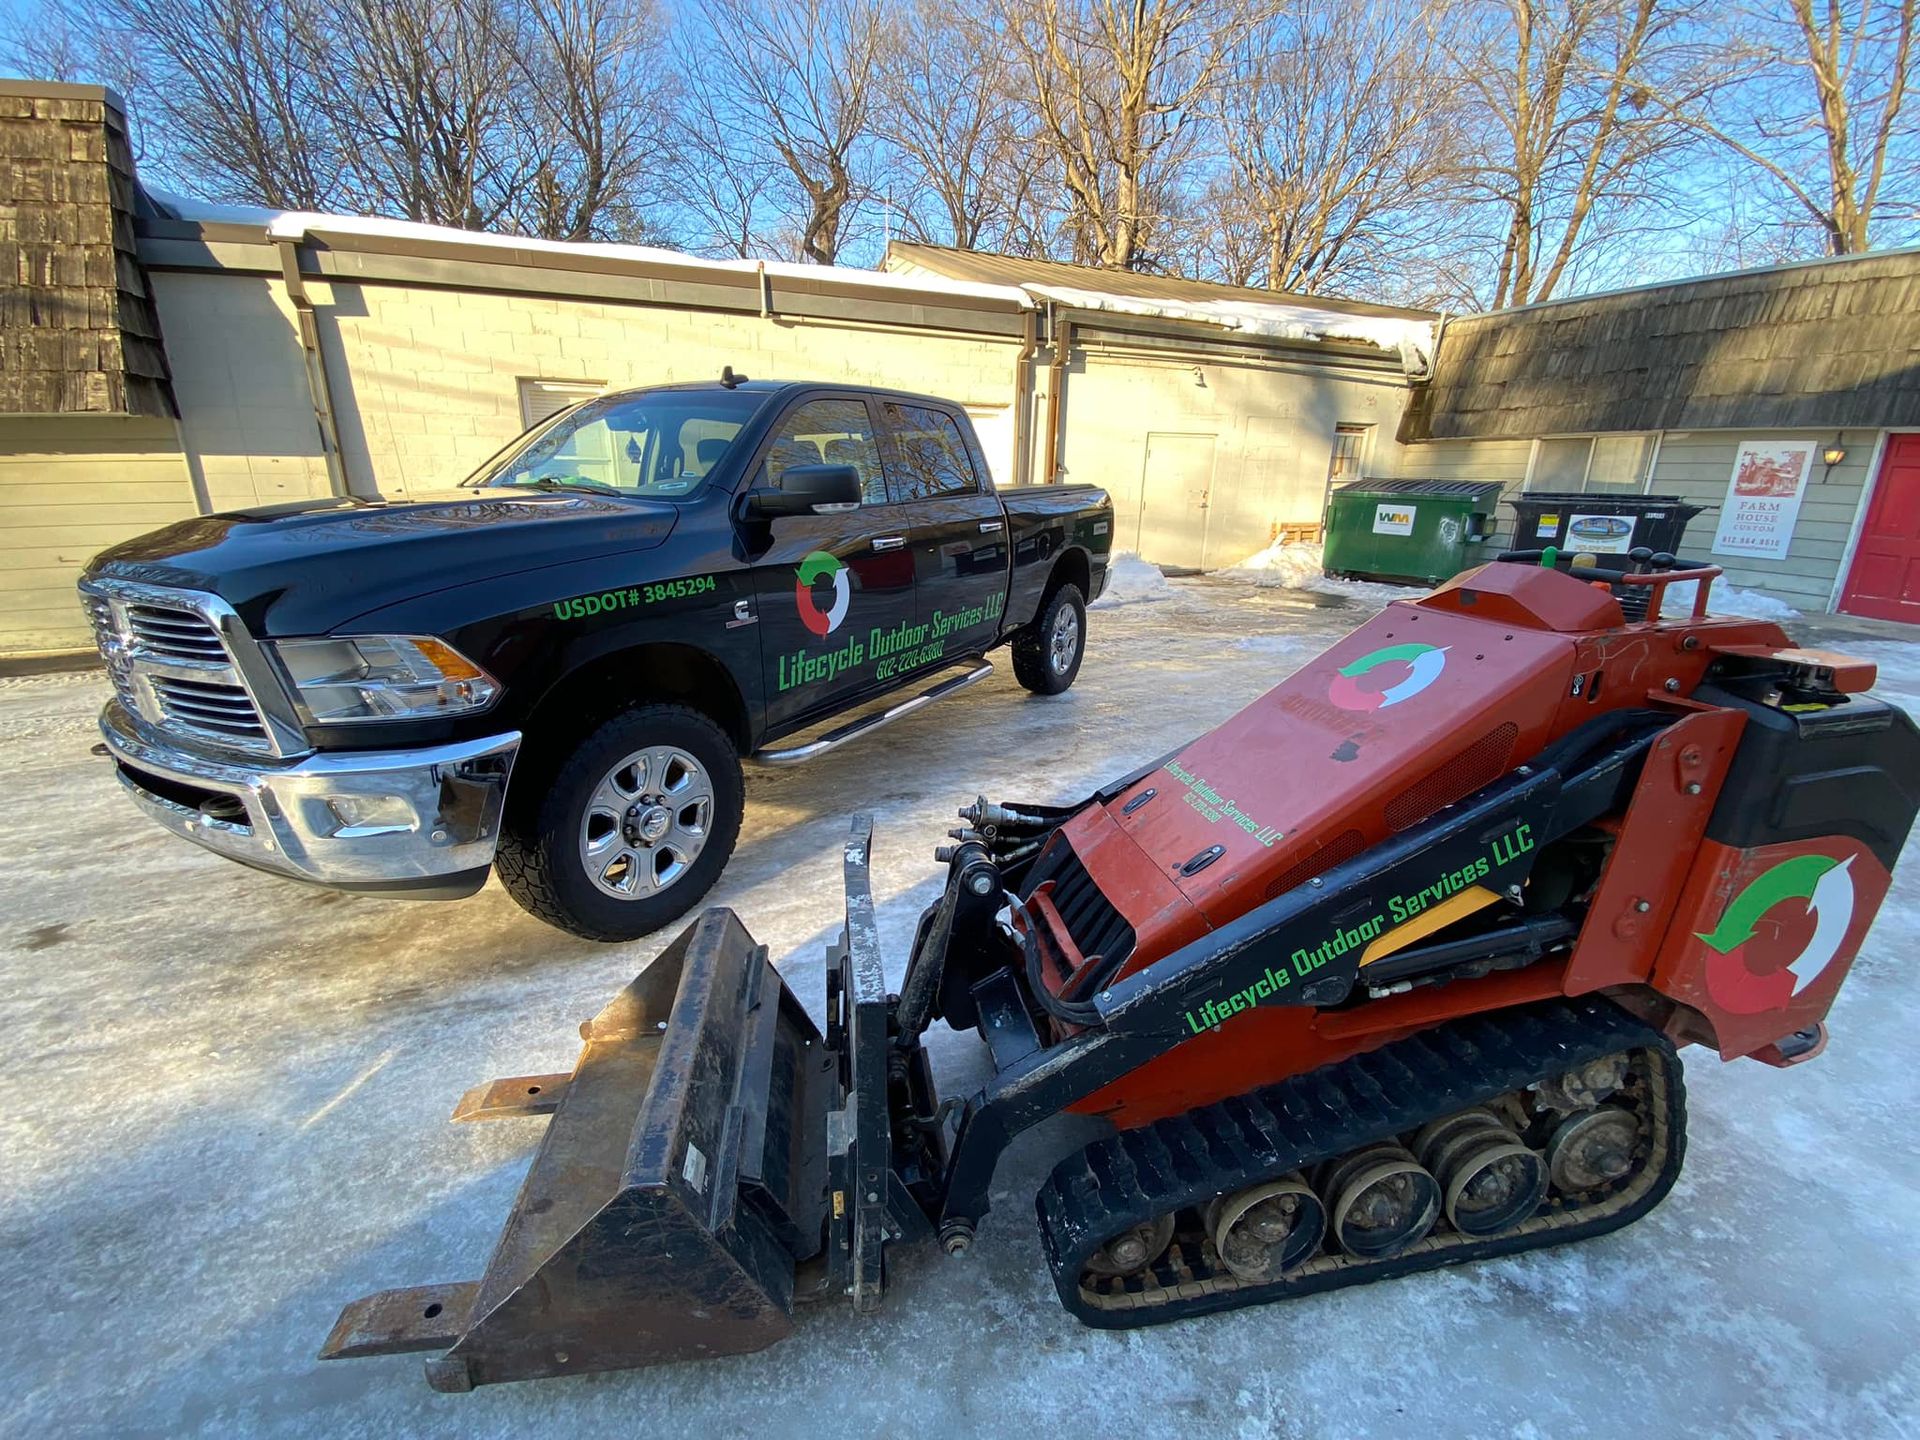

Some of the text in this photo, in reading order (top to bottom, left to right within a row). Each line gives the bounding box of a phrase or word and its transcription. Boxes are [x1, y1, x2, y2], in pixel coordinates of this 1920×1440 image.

[1379, 512, 1409, 523] WM
[1736, 513, 1777, 523] HOUSE
[1739, 501, 1781, 512] FARM
[1733, 524, 1775, 533] CUSTOM
[554, 576, 716, 621] USDOT# 3845294
[778, 591, 1005, 691] Lifecycle Outdoor Services LLC
[876, 639, 945, 680] 612-220-6380
[1219, 799, 1260, 834] Services
[1255, 825, 1285, 848] LLC
[1185, 824, 1536, 1034] Lifecycle Outdoor Services LLC
